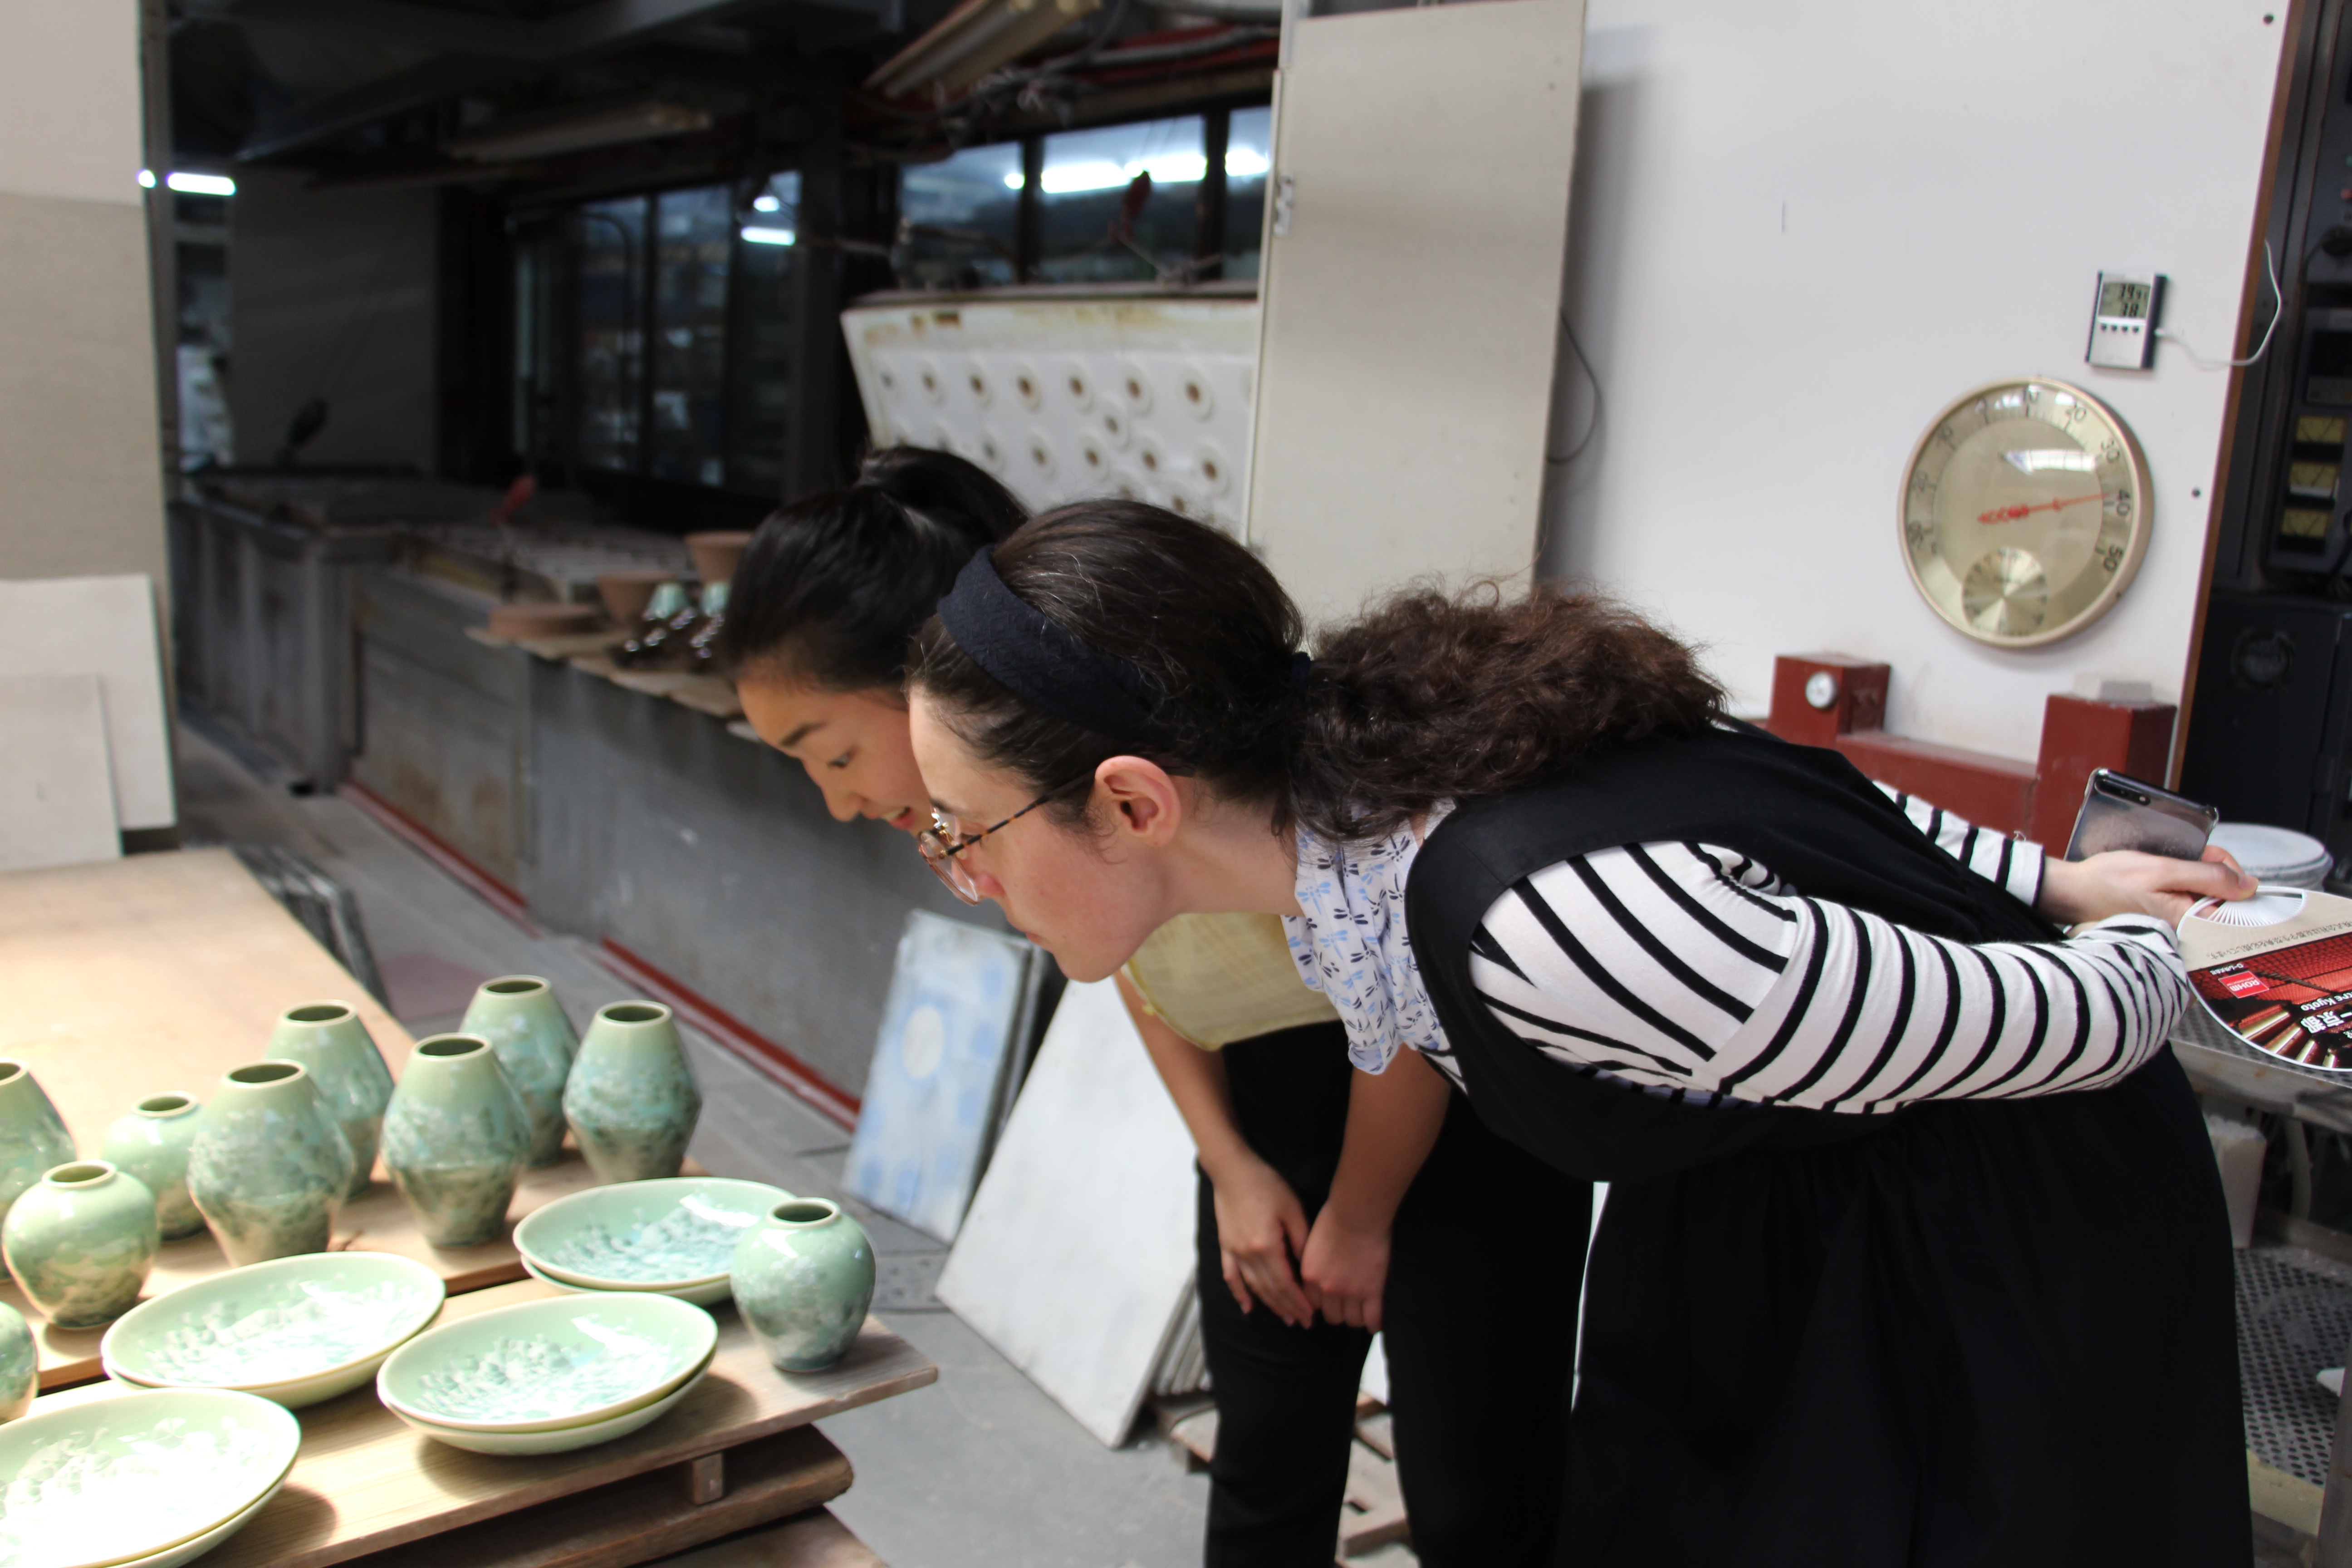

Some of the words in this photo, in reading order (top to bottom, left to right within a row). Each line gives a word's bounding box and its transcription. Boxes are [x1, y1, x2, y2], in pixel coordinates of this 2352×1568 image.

[2101, 438, 2121, 464] 30
[2116, 489, 2131, 516] 40
[2103, 544, 2124, 572] 50
[2230, 979, 2260, 992] ROHM
[2300, 997, 2337, 1011] Kyoto
